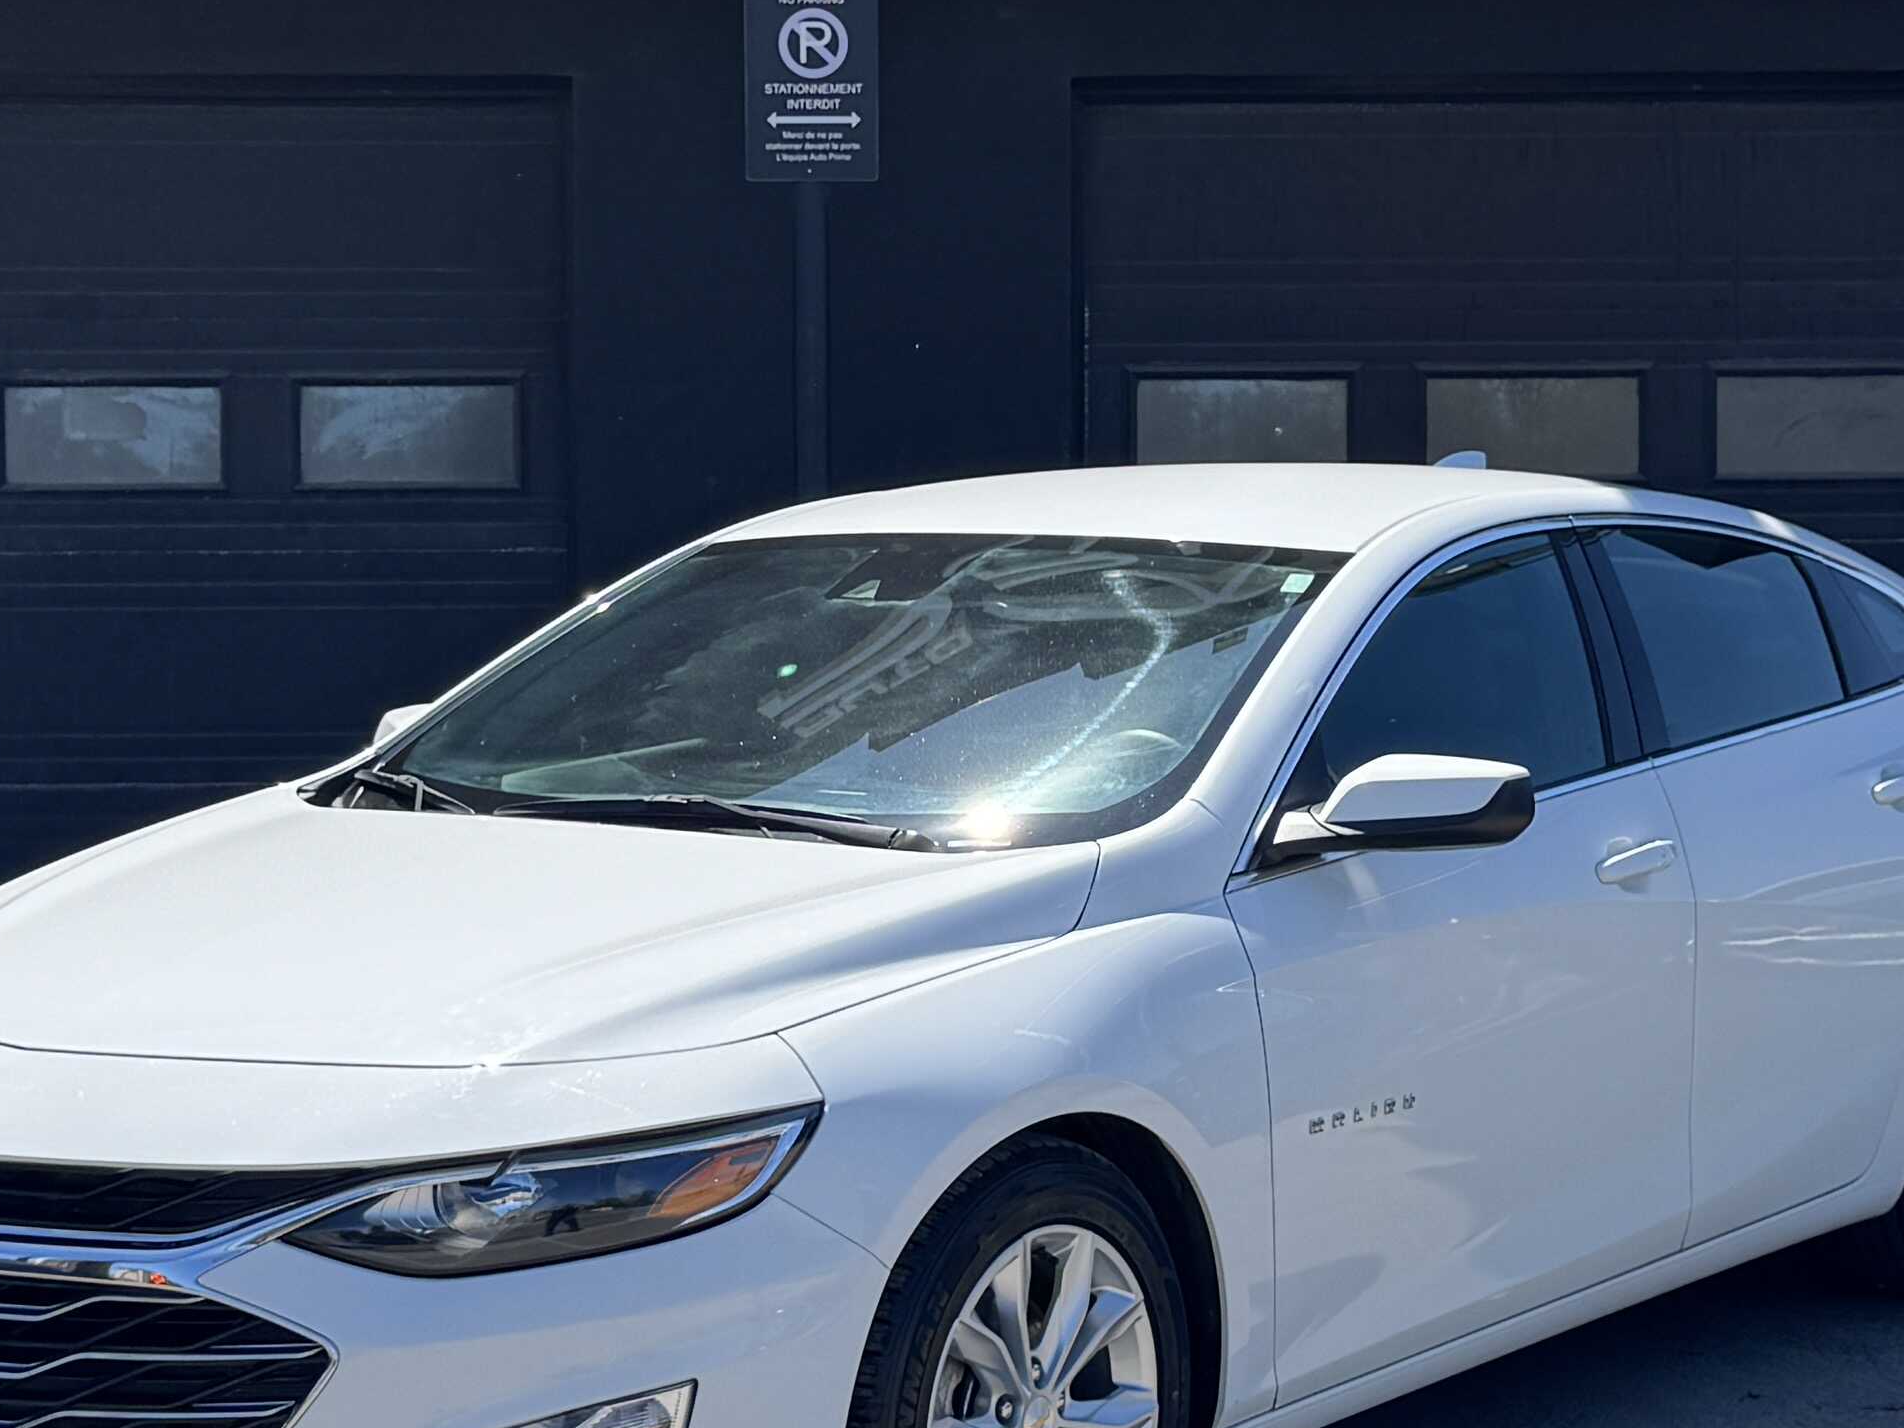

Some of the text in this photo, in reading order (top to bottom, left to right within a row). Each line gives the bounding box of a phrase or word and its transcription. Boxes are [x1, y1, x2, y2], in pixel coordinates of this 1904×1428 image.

[764, 83, 863, 94] STATIONNEMENT
[786, 98, 841, 110] INTERDIT
[809, 153, 827, 161] Auto
